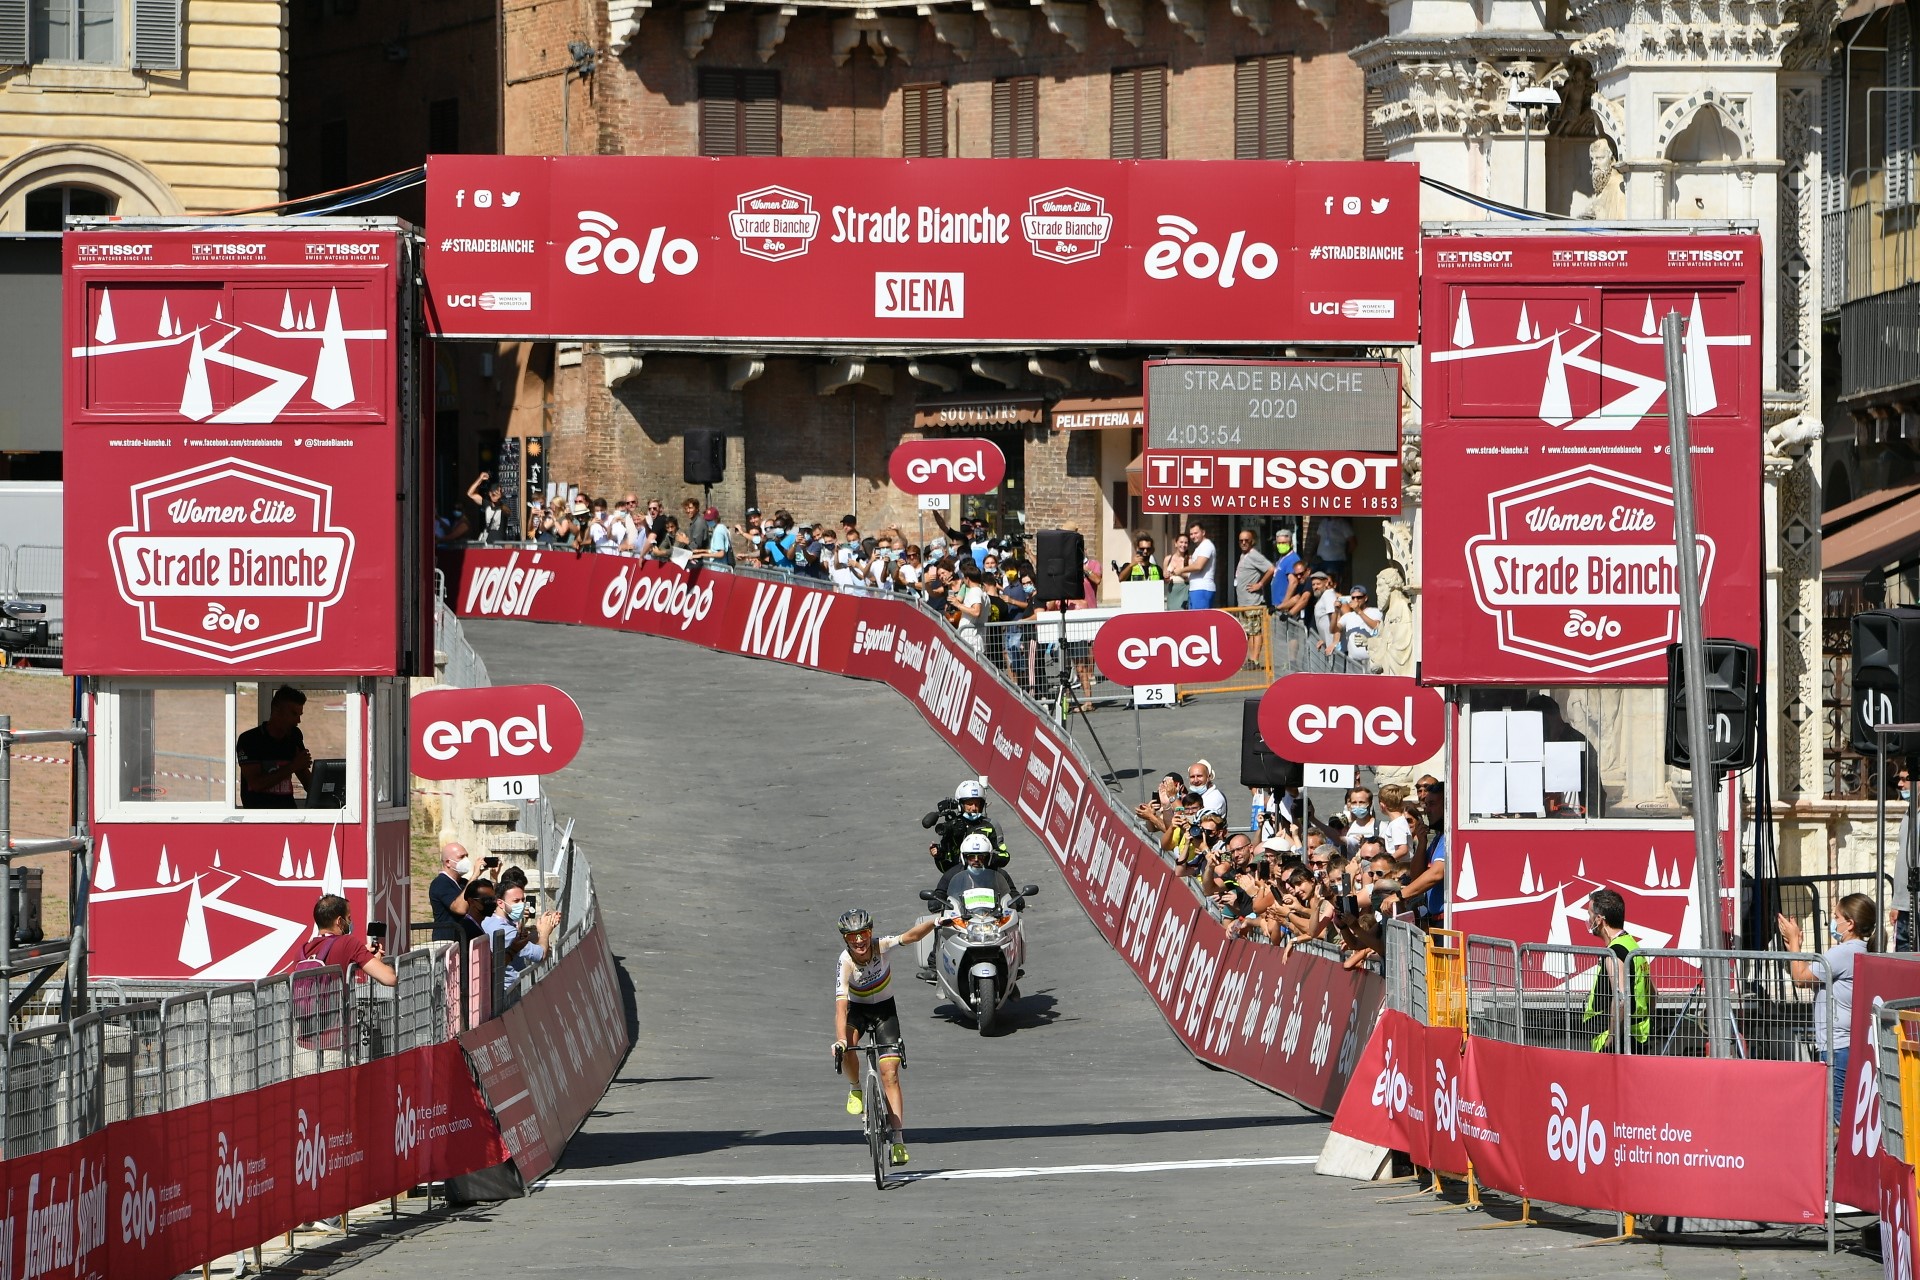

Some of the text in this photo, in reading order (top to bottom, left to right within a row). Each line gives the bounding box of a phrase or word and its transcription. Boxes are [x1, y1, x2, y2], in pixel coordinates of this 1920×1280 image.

[750, 197, 799, 210] Women Elite
[1042, 200, 1091, 213] Women Elite
[738, 217, 810, 234] Strade Bianche
[830, 205, 1010, 244] Strade Bianche
[1031, 220, 1102, 236] Strade Bianche
[99, 244, 153, 255] TISSOT
[213, 244, 266, 255] TISSOT
[326, 244, 379, 254] TISSOT
[440, 238, 534, 254] #STRADEBIANCHE
[565, 222, 699, 284] eolo
[1309, 245, 1404, 261] #STRADEBIANCHE
[1459, 251, 1512, 262] TISSOT
[1574, 250, 1628, 261] TISSOT
[1689, 250, 1743, 261] TISSOT
[1144, 226, 1278, 288] eolo
[447, 294, 477, 308] UCI
[884, 278, 955, 312] SIENA
[1309, 301, 1340, 315] UCI
[1184, 371, 1363, 392] STRADE BIANCHE
[940, 405, 1018, 422] SOUVENIRS
[1056, 411, 1130, 428] PELLETTERIA
[1248, 399, 1298, 419] 2020
[305, 438, 353, 447] @StradeBianche
[1166, 424, 1242, 445] 4:03:54
[906, 449, 986, 484] enel
[1217, 456, 1398, 490] TISSOT
[168, 497, 297, 524] Women Elite
[927, 496, 942, 508] 50
[1147, 494, 1398, 509] SWISS WATCHES SINCE 1853
[1525, 505, 1656, 532] Women Elite
[136, 547, 327, 586] Strade Bianche
[1493, 556, 1579, 595] Strade
[465, 551, 551, 616] valsir
[625, 570, 714, 630] prologo
[202, 606, 259, 633] eolo
[1564, 613, 1621, 640] eolo
[864, 623, 896, 655] sportful
[1117, 625, 1222, 670] enel
[919, 636, 972, 736] SHIMANO
[1145, 688, 1163, 701] 25
[1288, 696, 1417, 746] enel
[423, 704, 552, 760] enel
[1319, 768, 1339, 784] 10
[503, 780, 522, 796] 10
[1546, 1098, 1606, 1175] eolo
[1613, 1121, 1692, 1142] Internet dove
[295, 1117, 326, 1191] eolo
[1614, 1144, 1745, 1169] gli altri non arrivano
[215, 1141, 244, 1219] eolo
[121, 1166, 156, 1250] eolo
